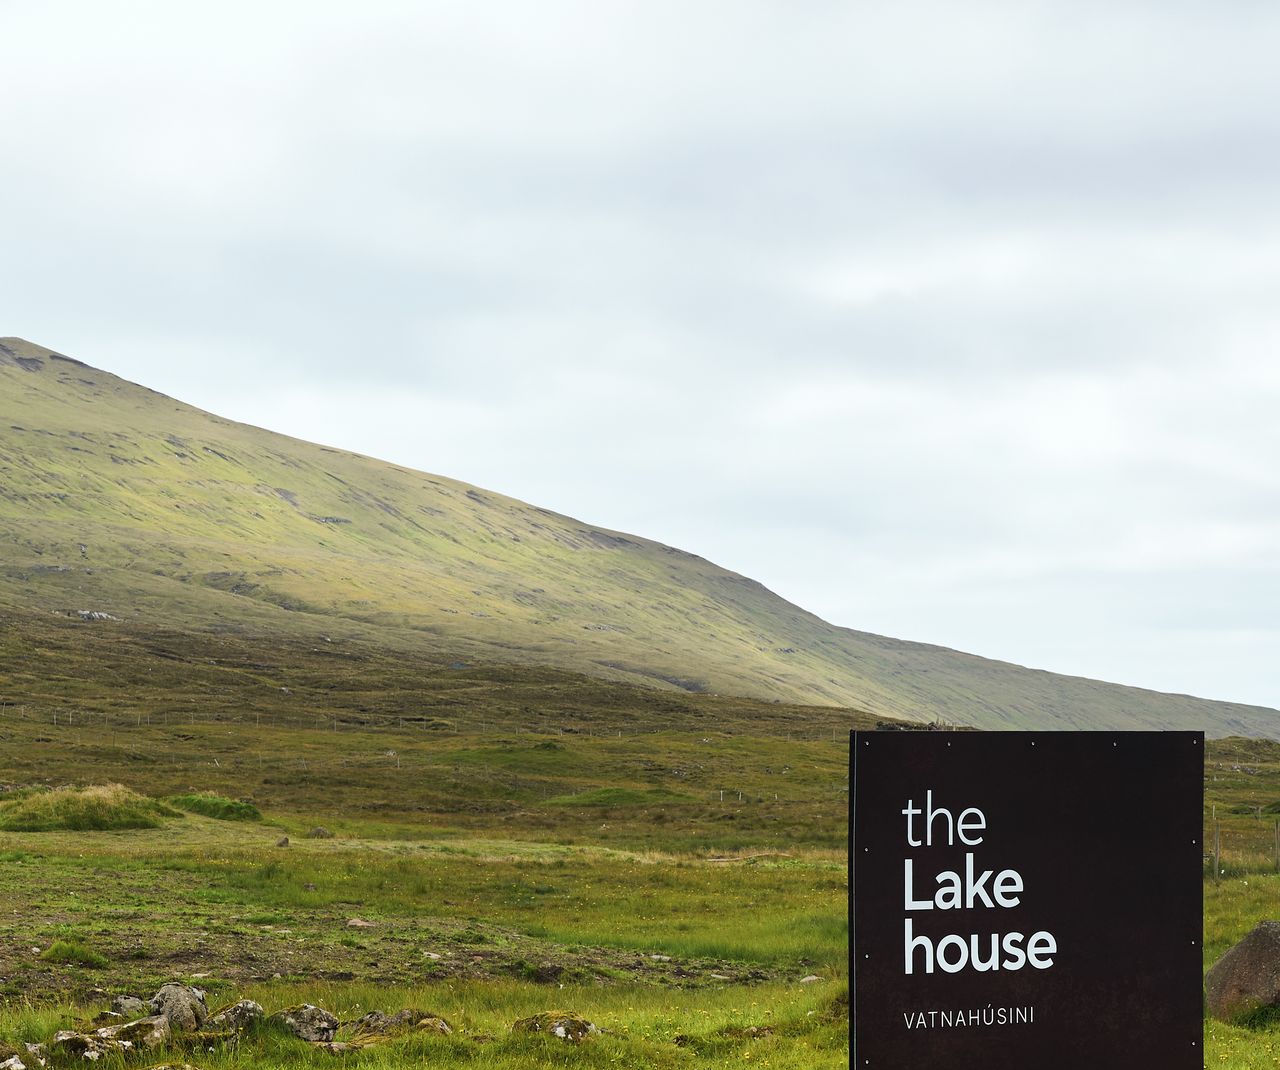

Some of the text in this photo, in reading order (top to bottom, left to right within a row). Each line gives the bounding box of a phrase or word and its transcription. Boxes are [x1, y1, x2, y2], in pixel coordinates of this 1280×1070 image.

[901, 789, 987, 847] the
[904, 852, 1024, 911] Lake
[904, 917, 1058, 975] house
[903, 1004, 1035, 1030] VATNAHÚSINI
